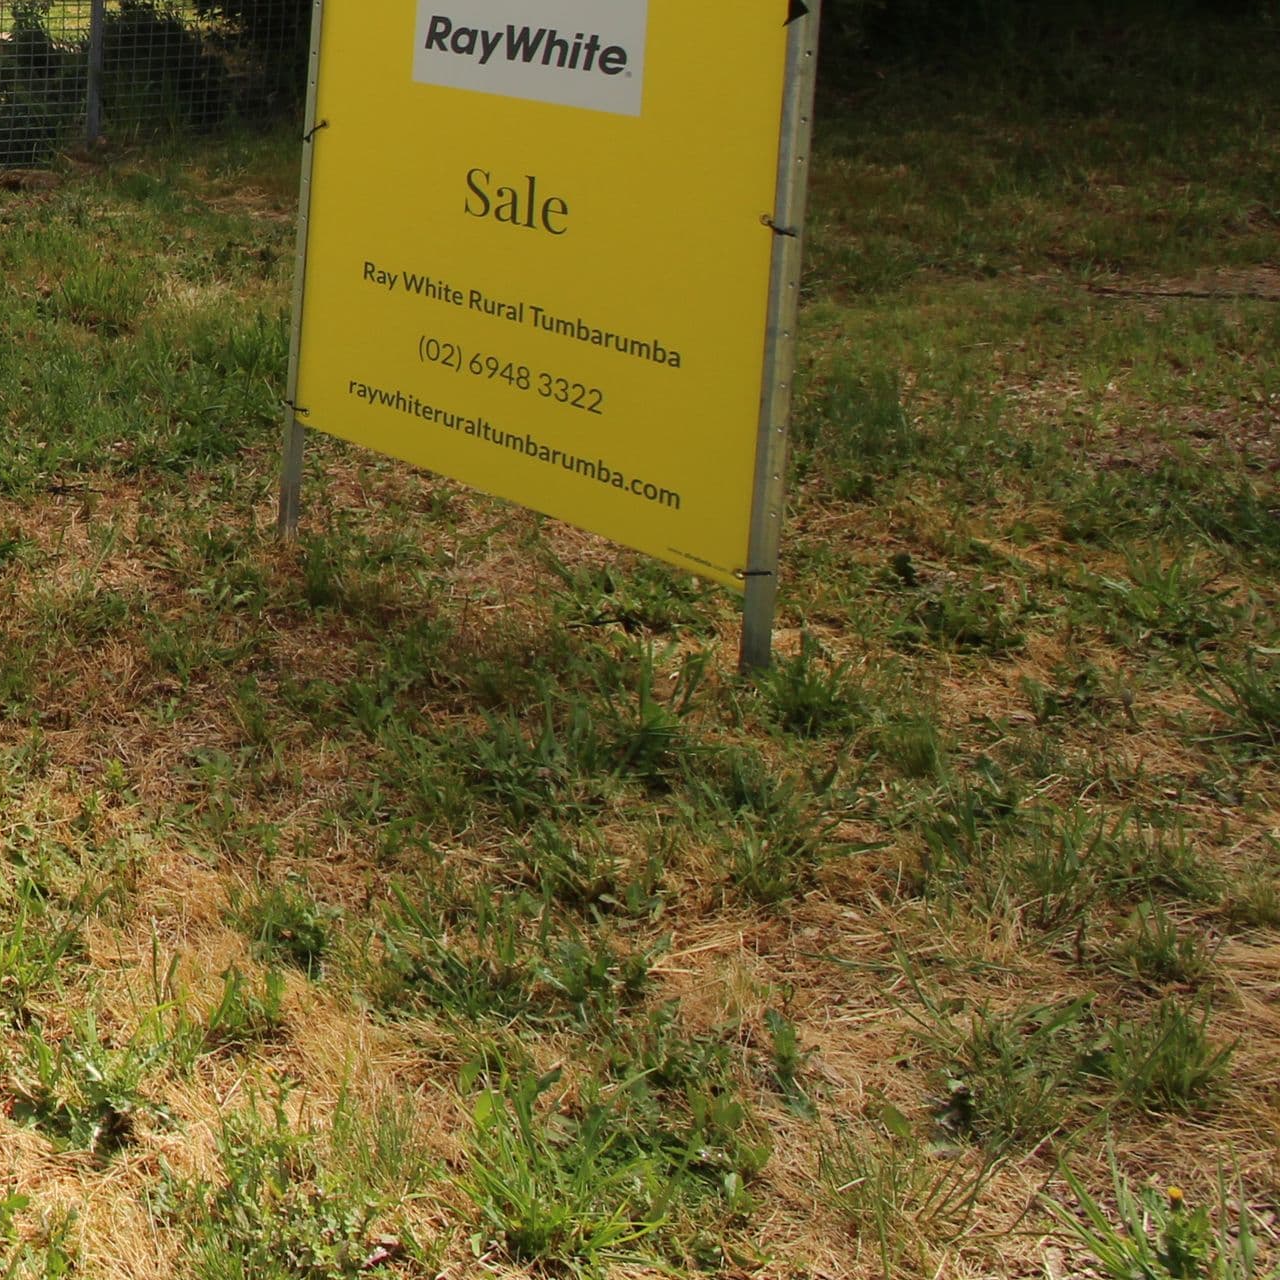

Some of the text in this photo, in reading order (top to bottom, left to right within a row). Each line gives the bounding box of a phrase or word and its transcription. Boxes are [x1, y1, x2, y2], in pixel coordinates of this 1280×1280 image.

[464, 168, 569, 235] Sale
[363, 261, 682, 369] Ray White Rural Tumbarumba
[418, 335, 604, 416] (02) 6948 3322
[348, 380, 681, 511] raywhiteruraltumbarumba.com
